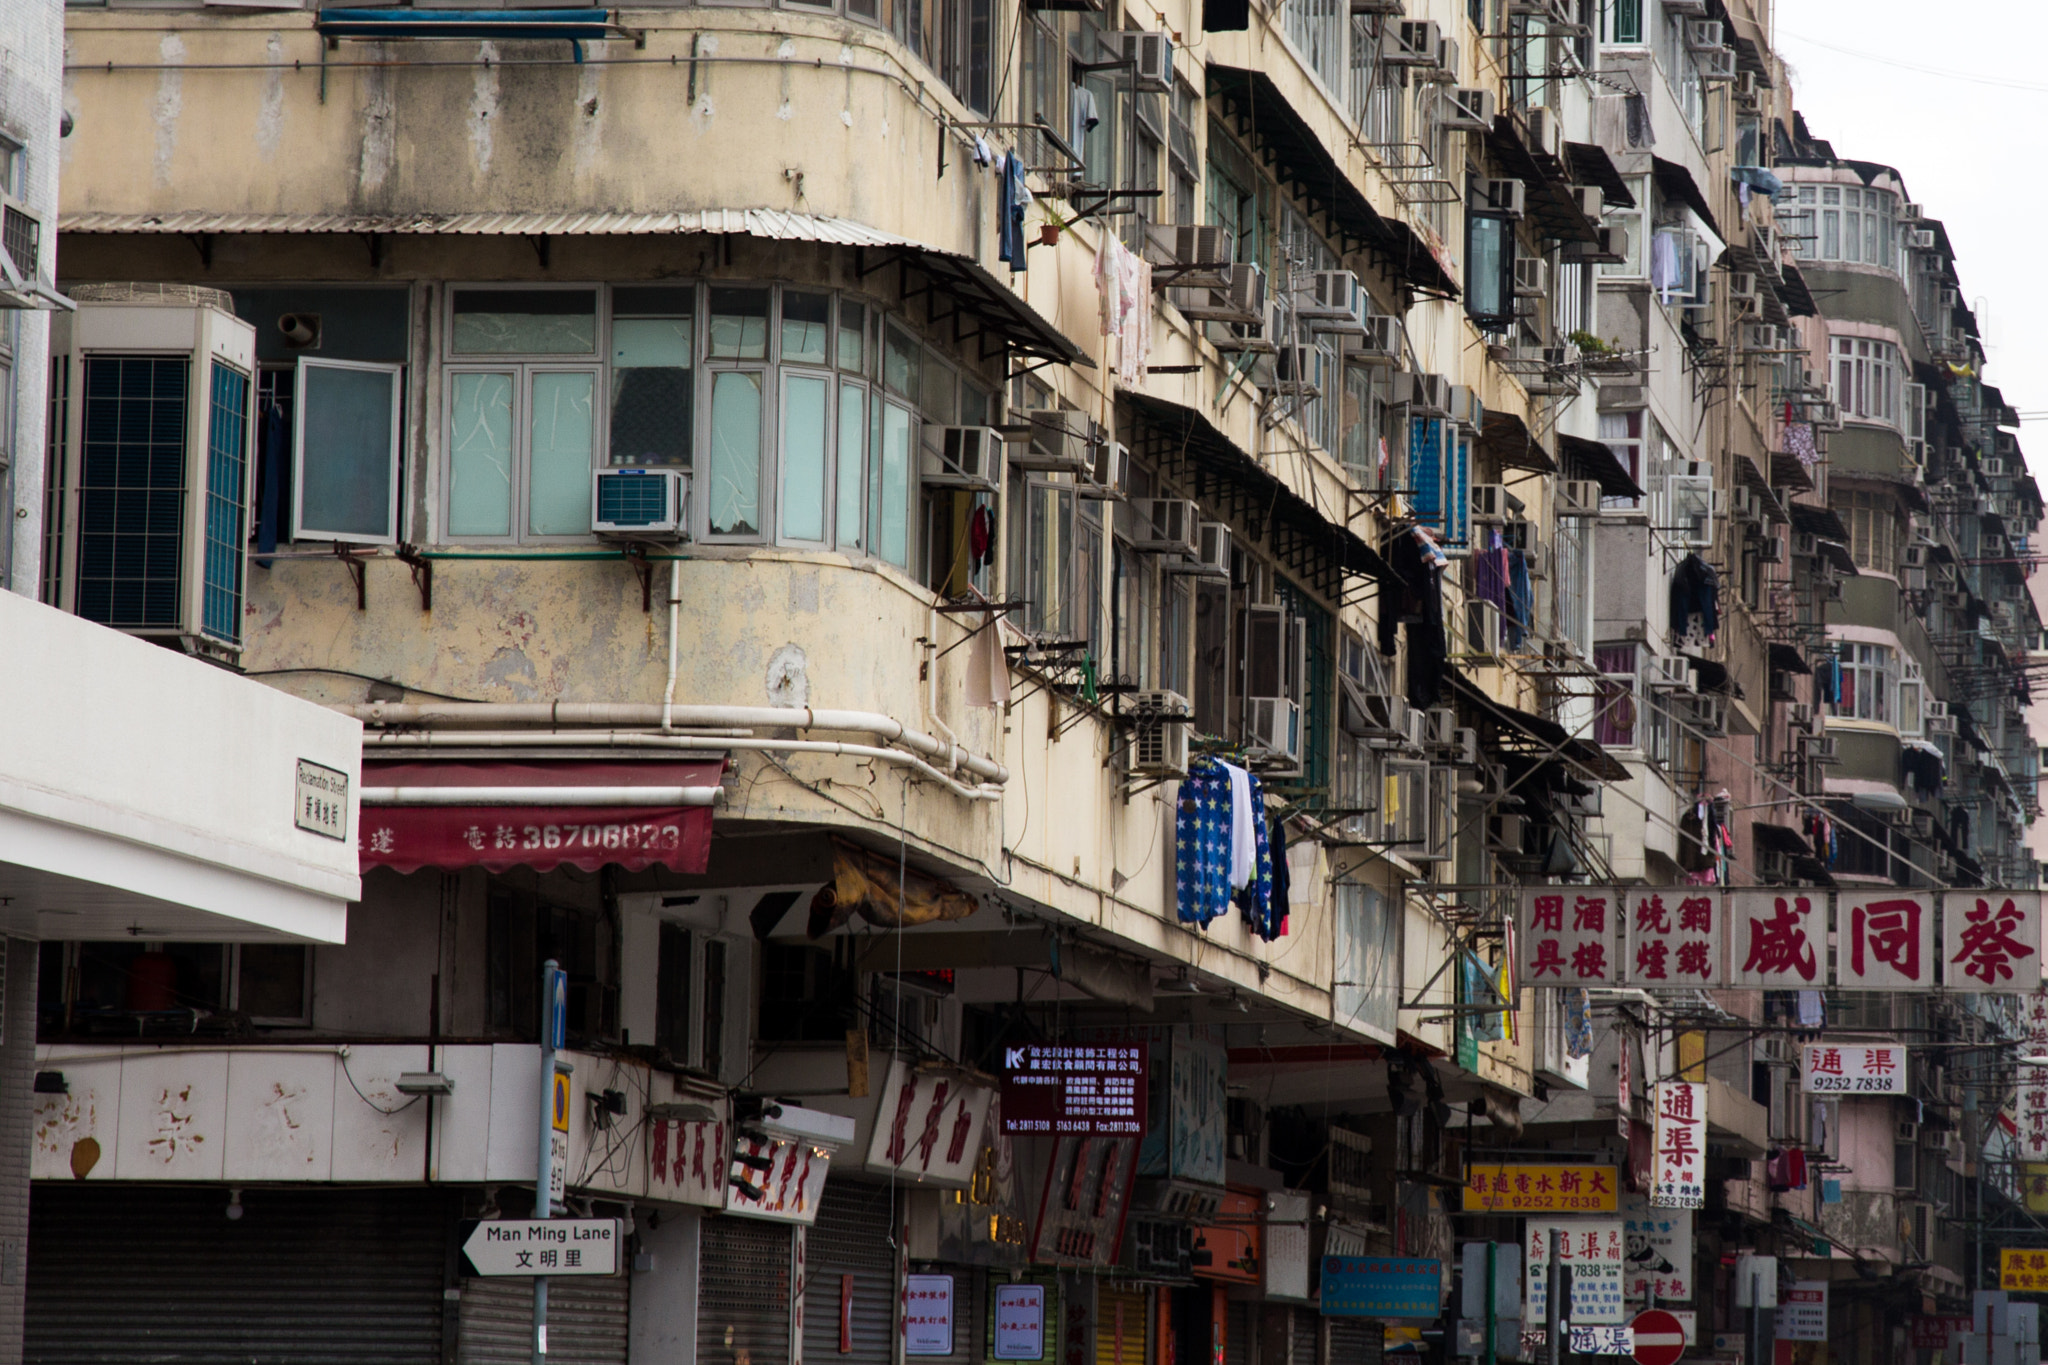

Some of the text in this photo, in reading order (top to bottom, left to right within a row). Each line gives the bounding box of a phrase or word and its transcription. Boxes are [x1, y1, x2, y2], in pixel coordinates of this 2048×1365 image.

[299, 766, 345, 797] Reclamation Street
[464, 825, 516, 850] 電話
[1811, 1048, 1896, 1075] 通渠
[1814, 1077, 1892, 1090] 9252 7838
[1660, 1084, 1700, 1167] 通渠
[1512, 1196, 1553, 1208] 9252
[1560, 1196, 1601, 1208] 7838
[1653, 1196, 1703, 1208] 9252 7838
[487, 1227, 611, 1244] Man Ming Lane
[515, 1250, 582, 1268] 文明里
[1575, 1264, 1600, 1277] 7838
[1571, 1326, 1633, 1355] 通渠
